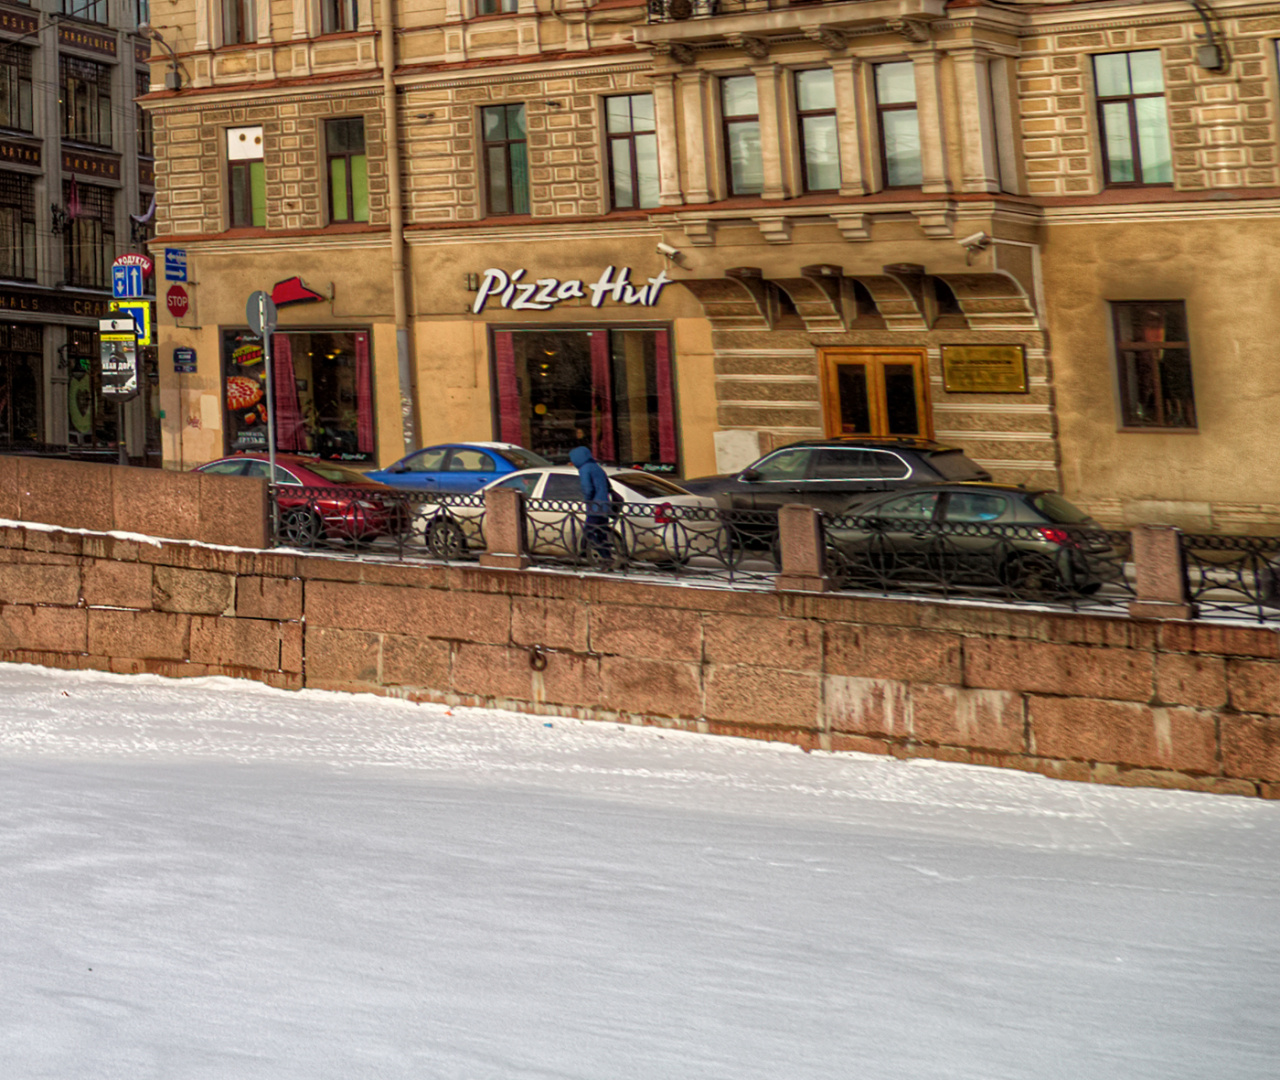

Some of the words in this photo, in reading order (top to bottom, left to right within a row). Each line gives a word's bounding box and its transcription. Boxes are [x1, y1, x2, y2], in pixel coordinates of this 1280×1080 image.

[167, 295, 188, 307] STOP
[473, 268, 586, 315] Pizza
[589, 265, 674, 309] Hut
